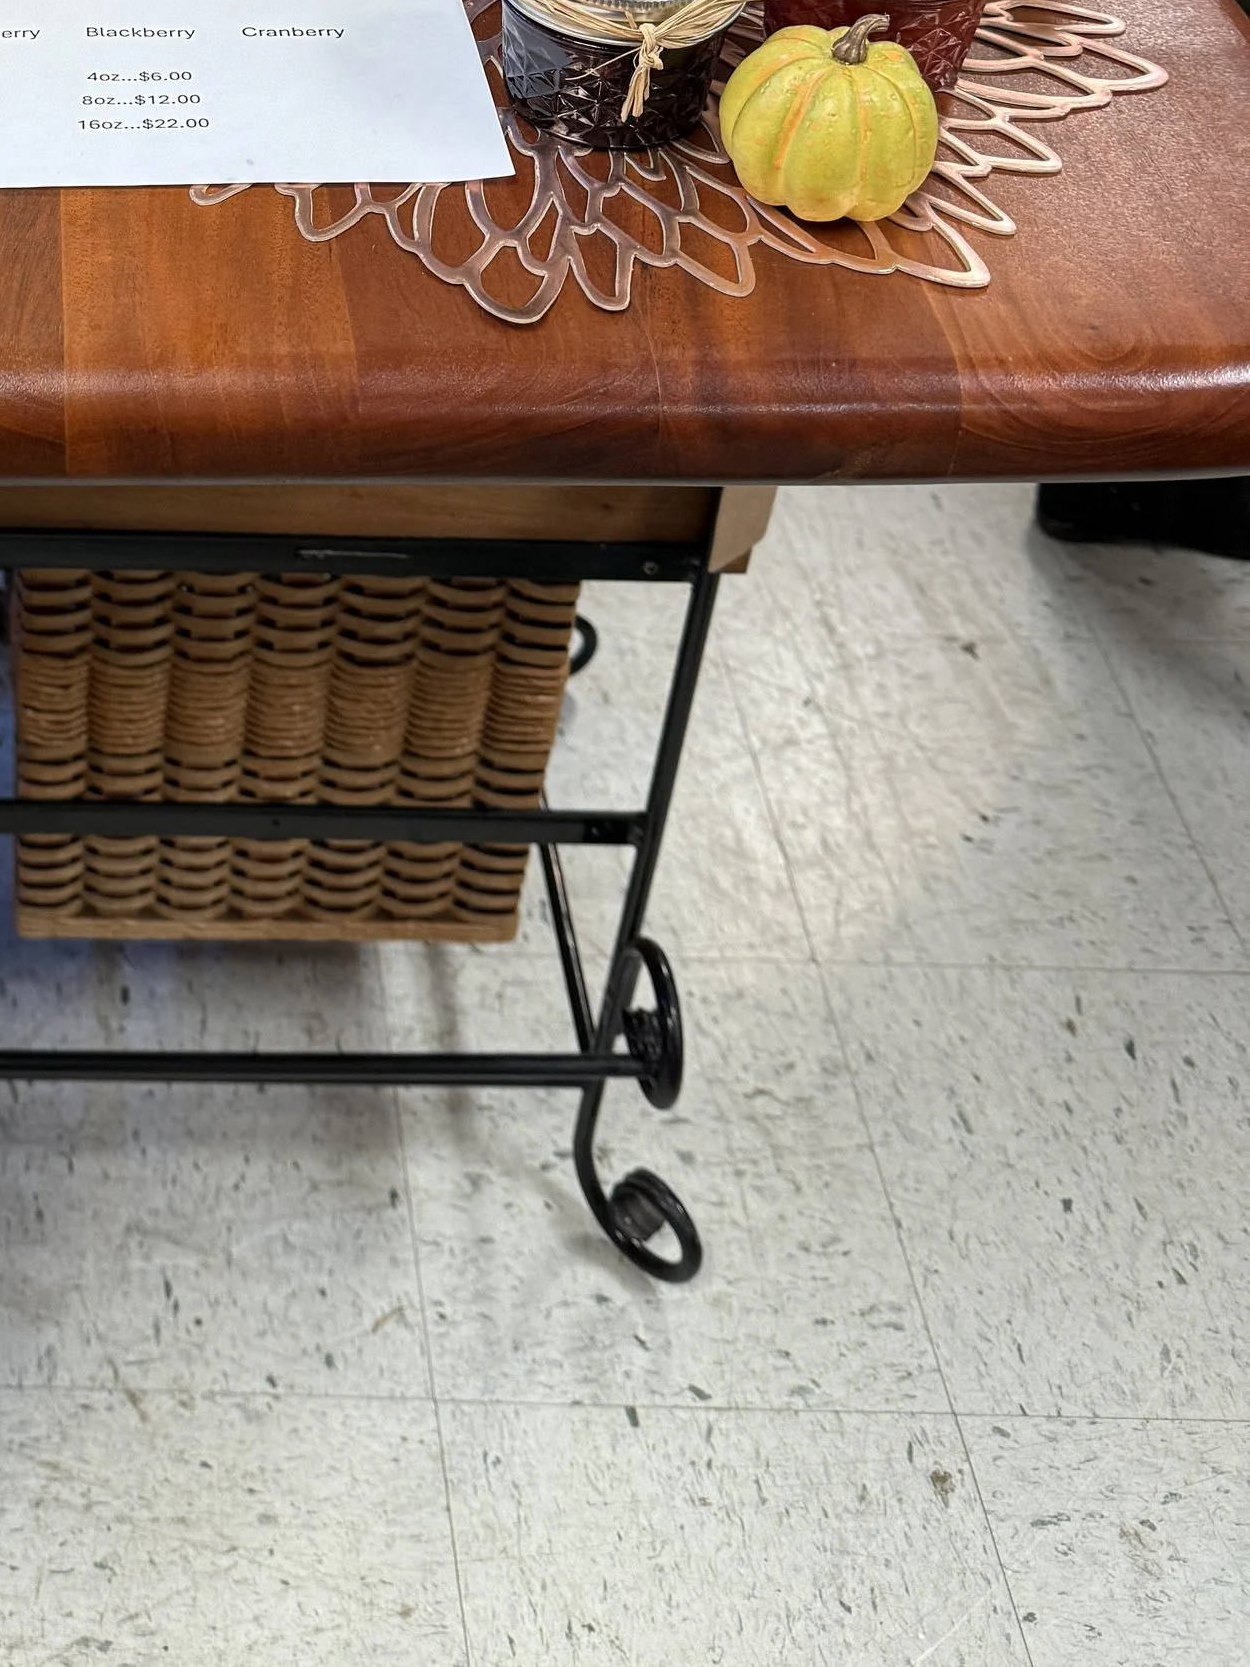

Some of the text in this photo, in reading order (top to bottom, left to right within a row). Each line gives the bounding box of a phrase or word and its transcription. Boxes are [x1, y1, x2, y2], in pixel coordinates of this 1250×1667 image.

[85, 26, 196, 40] Blackberry
[241, 25, 346, 40] Cranberry
[86, 70, 193, 83] 4oz...$6.00
[81, 93, 201, 107] 8oz...$12.00
[77, 116, 210, 131] 16oz...$22.00
